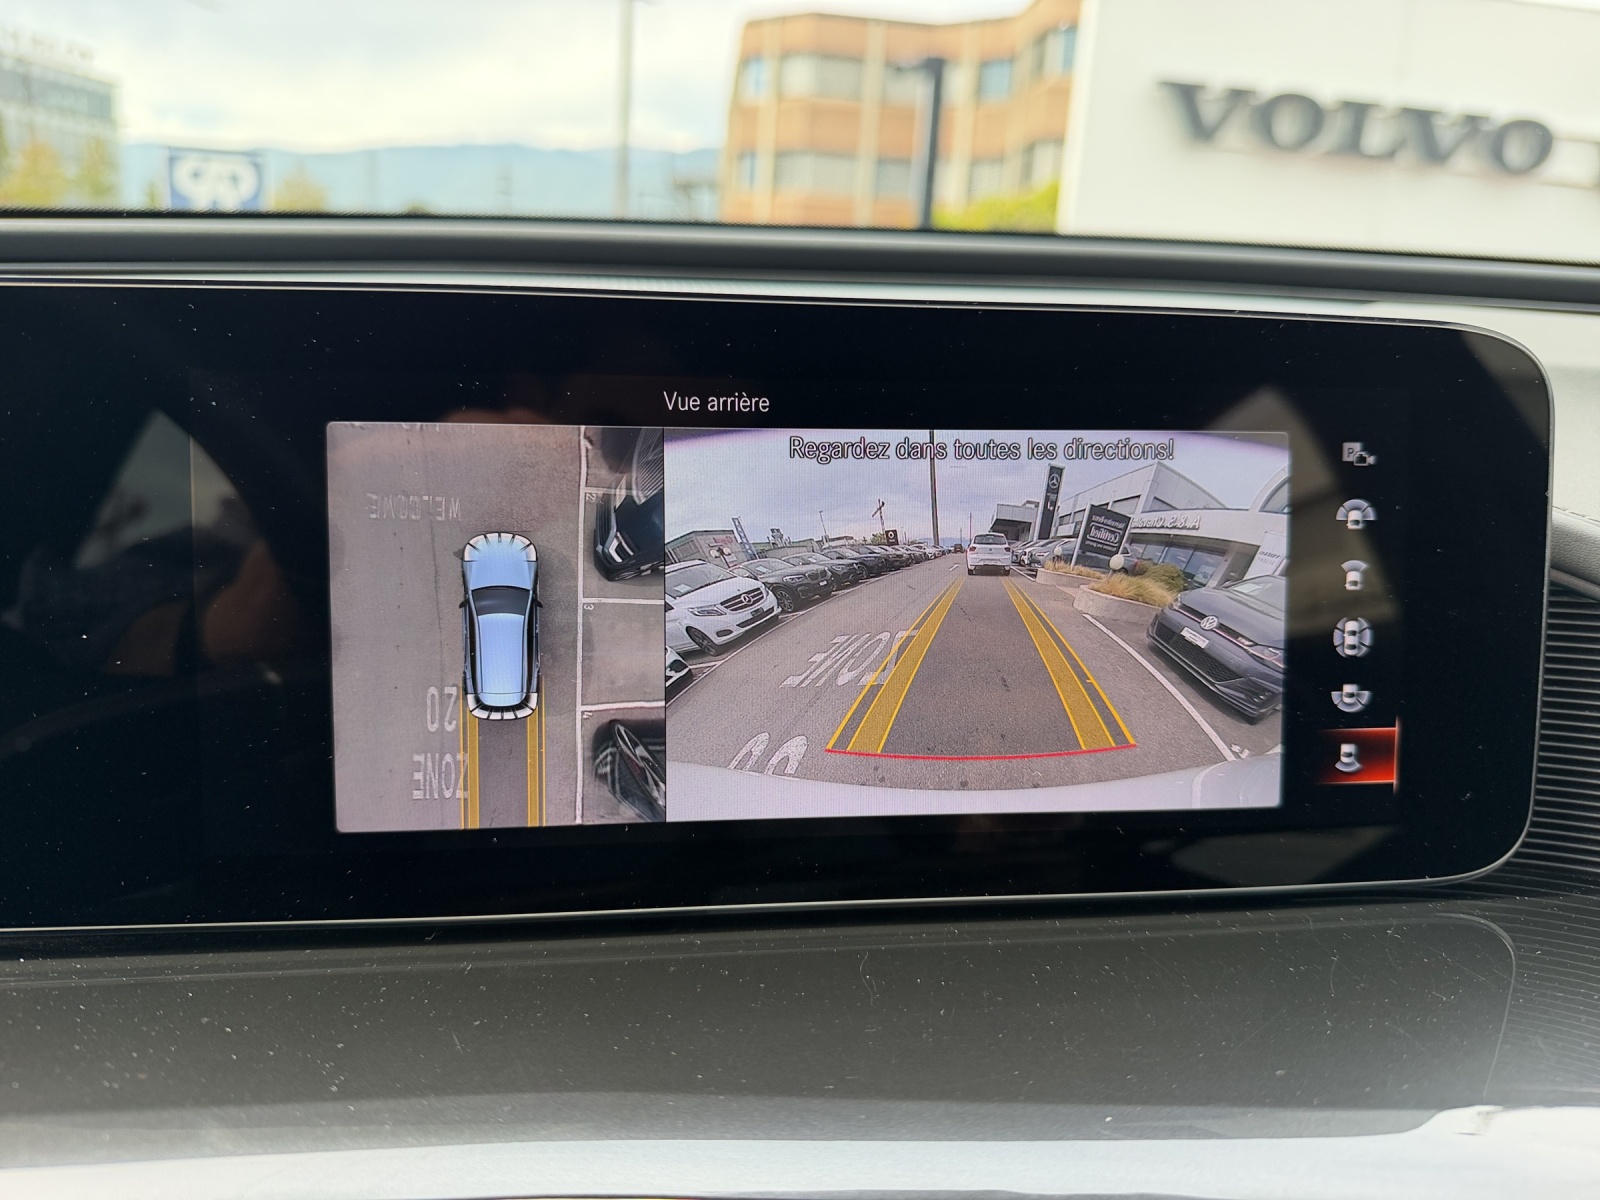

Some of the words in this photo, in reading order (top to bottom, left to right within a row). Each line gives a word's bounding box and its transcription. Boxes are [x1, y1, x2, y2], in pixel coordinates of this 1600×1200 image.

[1158, 81, 1554, 175] VOLVO
[663, 391, 701, 411] Vue
[707, 392, 770, 412] arrière
[789, 436, 890, 464] Regardez
[895, 437, 947, 460] dans
[954, 438, 1021, 461] toutes
[1027, 438, 1057, 461] les
[1063, 438, 1175, 461] directions!
[426, 686, 458, 732] 20
[412, 751, 469, 800] ZONE
